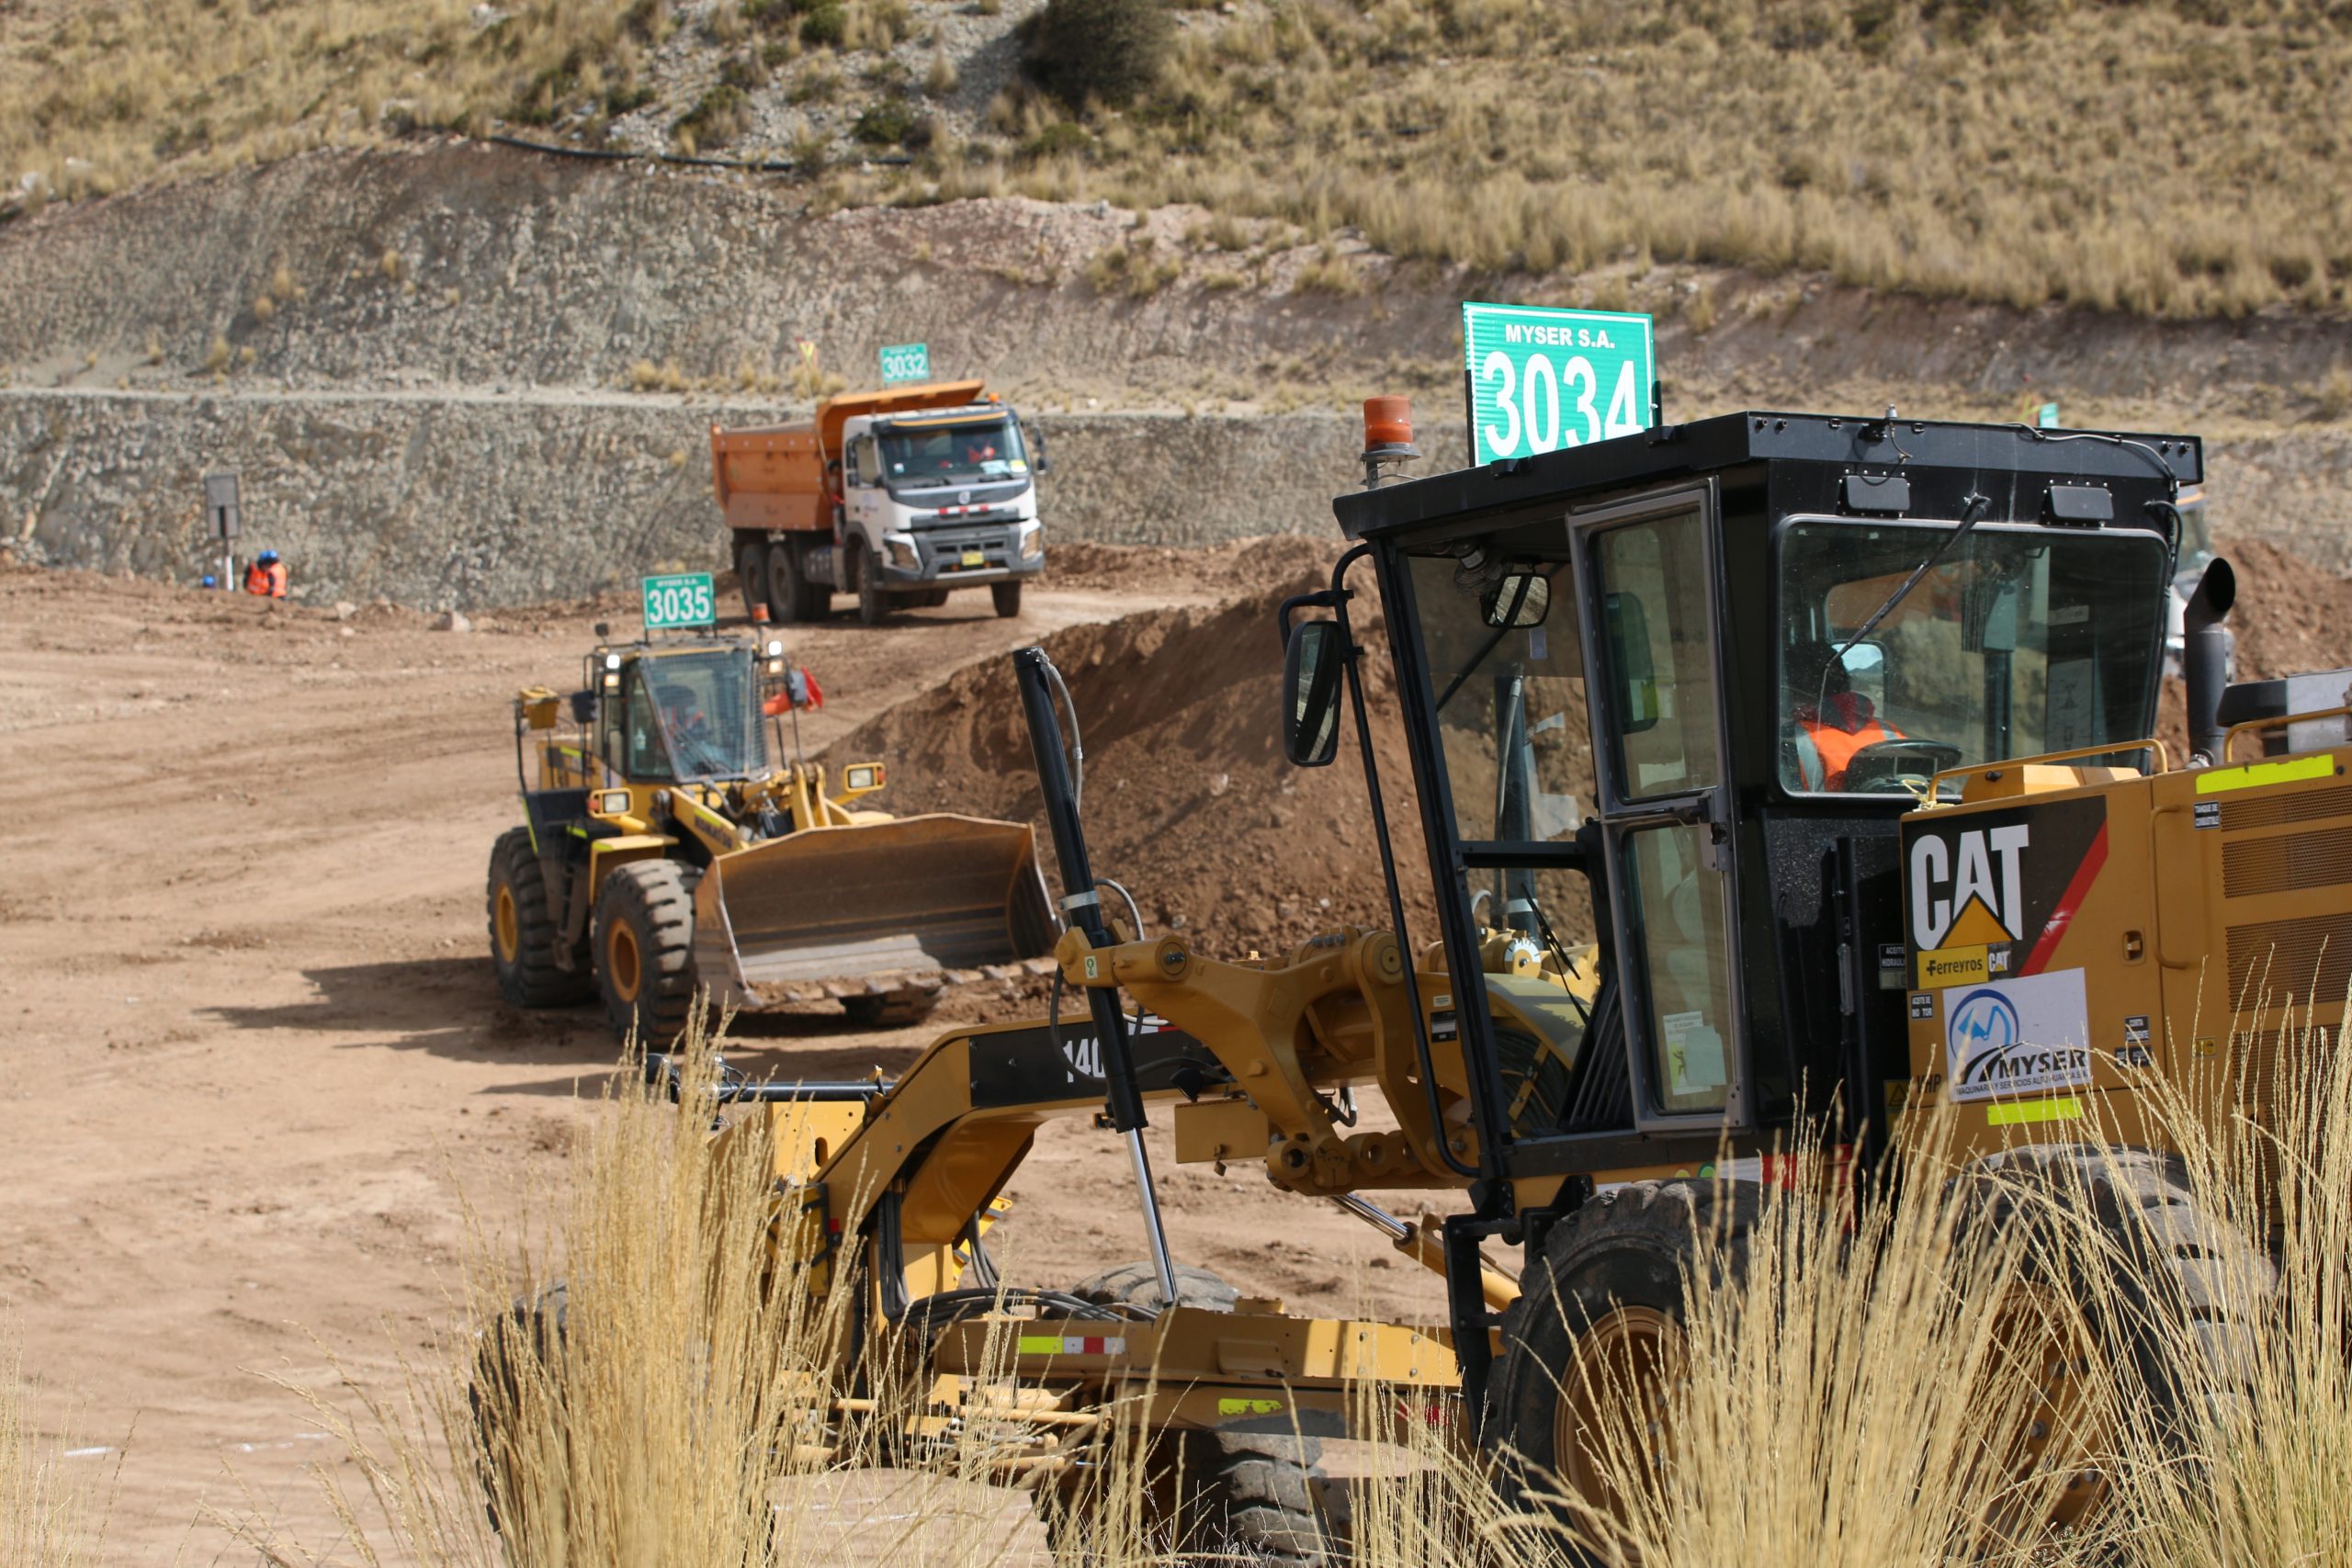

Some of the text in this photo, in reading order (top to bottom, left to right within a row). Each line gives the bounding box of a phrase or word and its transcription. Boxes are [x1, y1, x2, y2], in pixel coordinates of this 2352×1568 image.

[1505, 324, 1615, 349] MYSER S.A.
[883, 354, 925, 378] 3032
[1482, 351, 1644, 457] 3034
[648, 585, 710, 623] 3035
[1911, 824, 2029, 950] CAT
[1926, 958, 1983, 976] Ferreyros
[1988, 950, 2011, 972] CAT
[1998, 1049, 2086, 1078] MYSER
